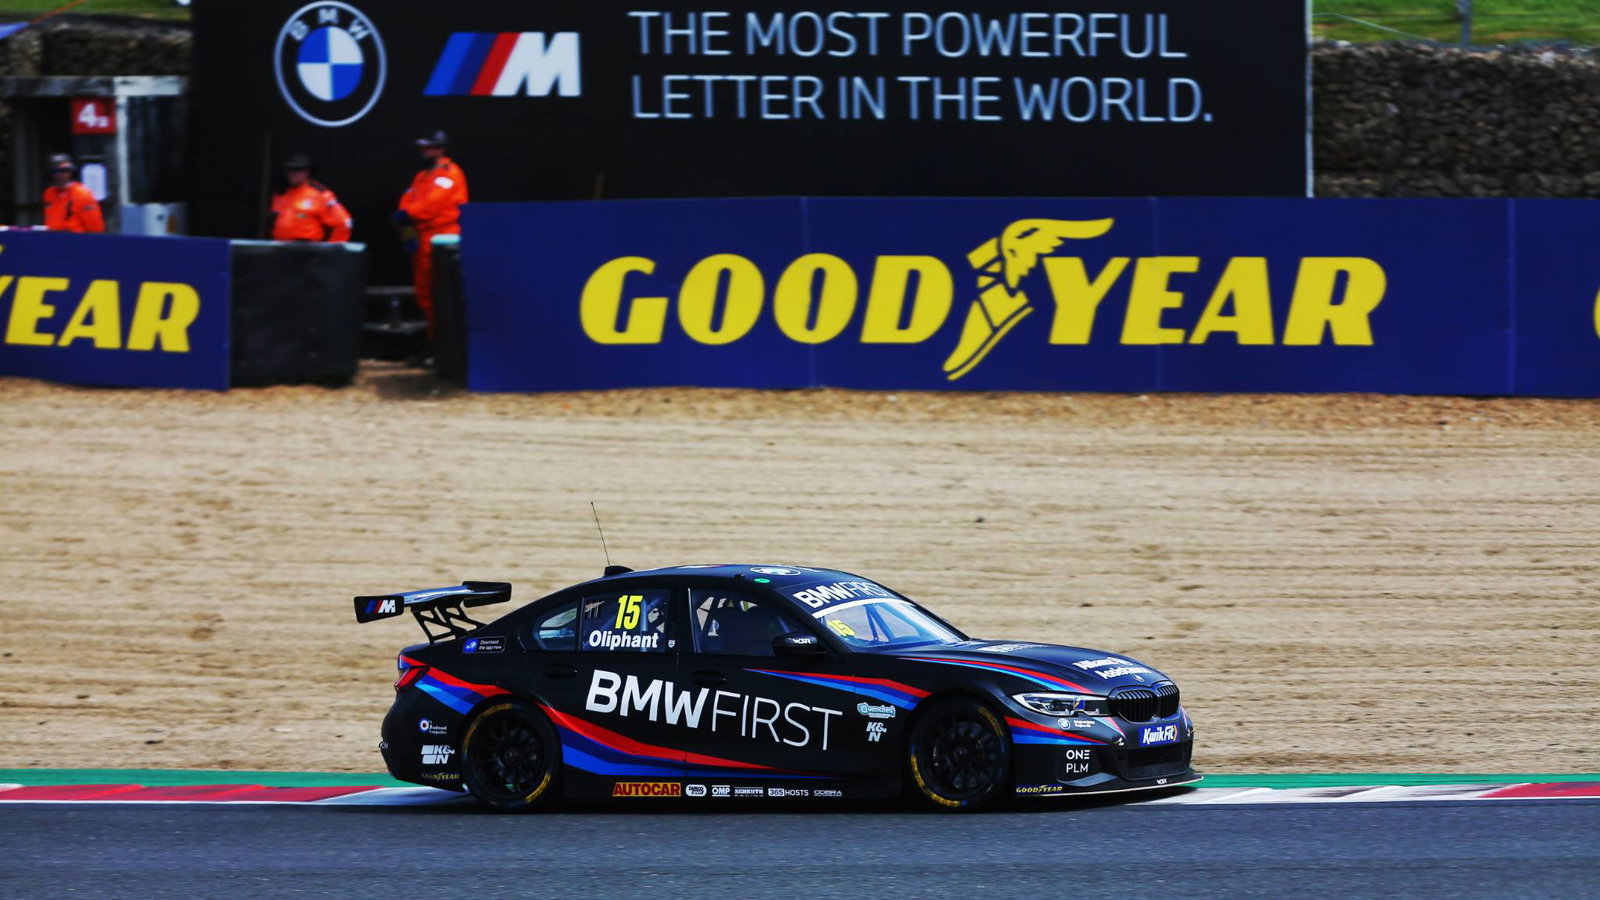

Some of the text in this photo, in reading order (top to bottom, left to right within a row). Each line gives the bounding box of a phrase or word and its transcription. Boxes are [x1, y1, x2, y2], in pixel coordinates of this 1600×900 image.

[627, 11, 1189, 58] THE MOST POWERFUL
[632, 74, 1213, 123] LETTER IN THE WORLD.
[0, 274, 201, 353] EAR
[614, 594, 644, 630] 15
[826, 619, 856, 637] 15
[588, 629, 659, 650] Oliphant
[1065, 749, 1090, 760] ONE
[1065, 763, 1089, 773] PLM
[613, 783, 680, 796] AUTOCAR
[711, 787, 731, 795] OMP
